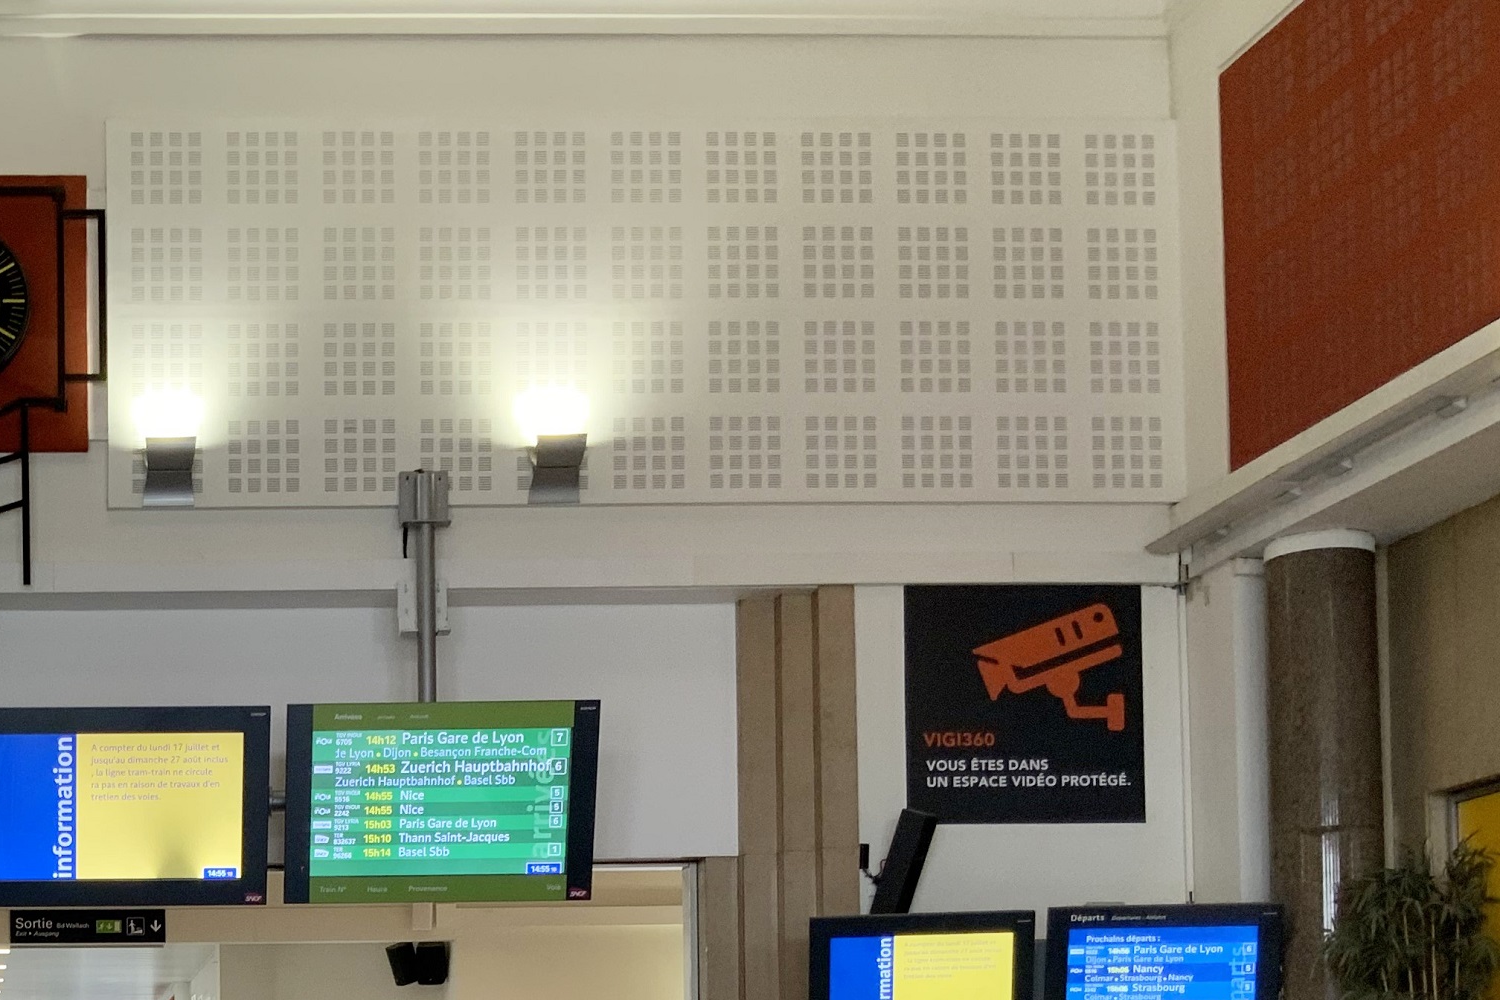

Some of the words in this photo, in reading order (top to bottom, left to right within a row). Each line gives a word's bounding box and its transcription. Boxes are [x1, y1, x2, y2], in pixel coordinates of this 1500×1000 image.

[366, 735, 396, 745] 14h12
[402, 732, 433, 745] Paris
[437, 731, 469, 744] Gare
[472, 731, 489, 744] de
[492, 731, 524, 746] Lyon
[924, 732, 995, 747] VIGI360
[350, 748, 373, 760] Lyon
[383, 747, 411, 760] Dijon
[420, 746, 470, 759] Besançon
[474, 746, 547, 757] Franche-Com
[365, 764, 396, 774] 14h53
[401, 761, 450, 774] Zuerich
[455, 758, 551, 775] Hauptbahnhof
[926, 760, 966, 772] VOUS
[971, 758, 1004, 771] ÊTES
[1008, 759, 1049, 771] DANS
[335, 777, 375, 787] Zuerich
[379, 775, 455, 788] Hauptbahnhof
[464, 776, 492, 785] Basel
[495, 775, 515, 785] Sbb
[926, 776, 949, 788] UN
[953, 776, 1007, 788] ESPACE
[1012, 774, 1057, 787] VIDÉO
[1061, 772, 1132, 787] PROTÉGÉ.
[365, 792, 393, 801] 14h55
[400, 790, 424, 800] Nice
[53, 737, 73, 879] information
[400, 804, 424, 814] Nice
[364, 820, 391, 829] 15h03
[399, 819, 425, 829] Paris
[427, 818, 452, 828] Gare
[455, 818, 468, 828] de
[471, 818, 496, 830] Lyon
[363, 834, 391, 843] 15h10
[399, 832, 432, 843] Thann
[434, 831, 510, 844] Saint-Jacques
[363, 848, 391, 857] 15h14
[399, 847, 426, 857] Basel
[429, 846, 449, 857] Sbb
[15, 917, 53, 929] Sortie
[1071, 914, 1104, 923] Départs
[1086, 935, 1124, 943] Prochains
[1126, 935, 1156, 944] départs
[1134, 945, 1157, 954] Paris
[1159, 945, 1182, 954] Gare
[1185, 945, 1197, 954] de
[1199, 945, 1223, 955] Lyon
[1133, 965, 1164, 975] Nancy
[1132, 984, 1185, 994] Strasbourg
